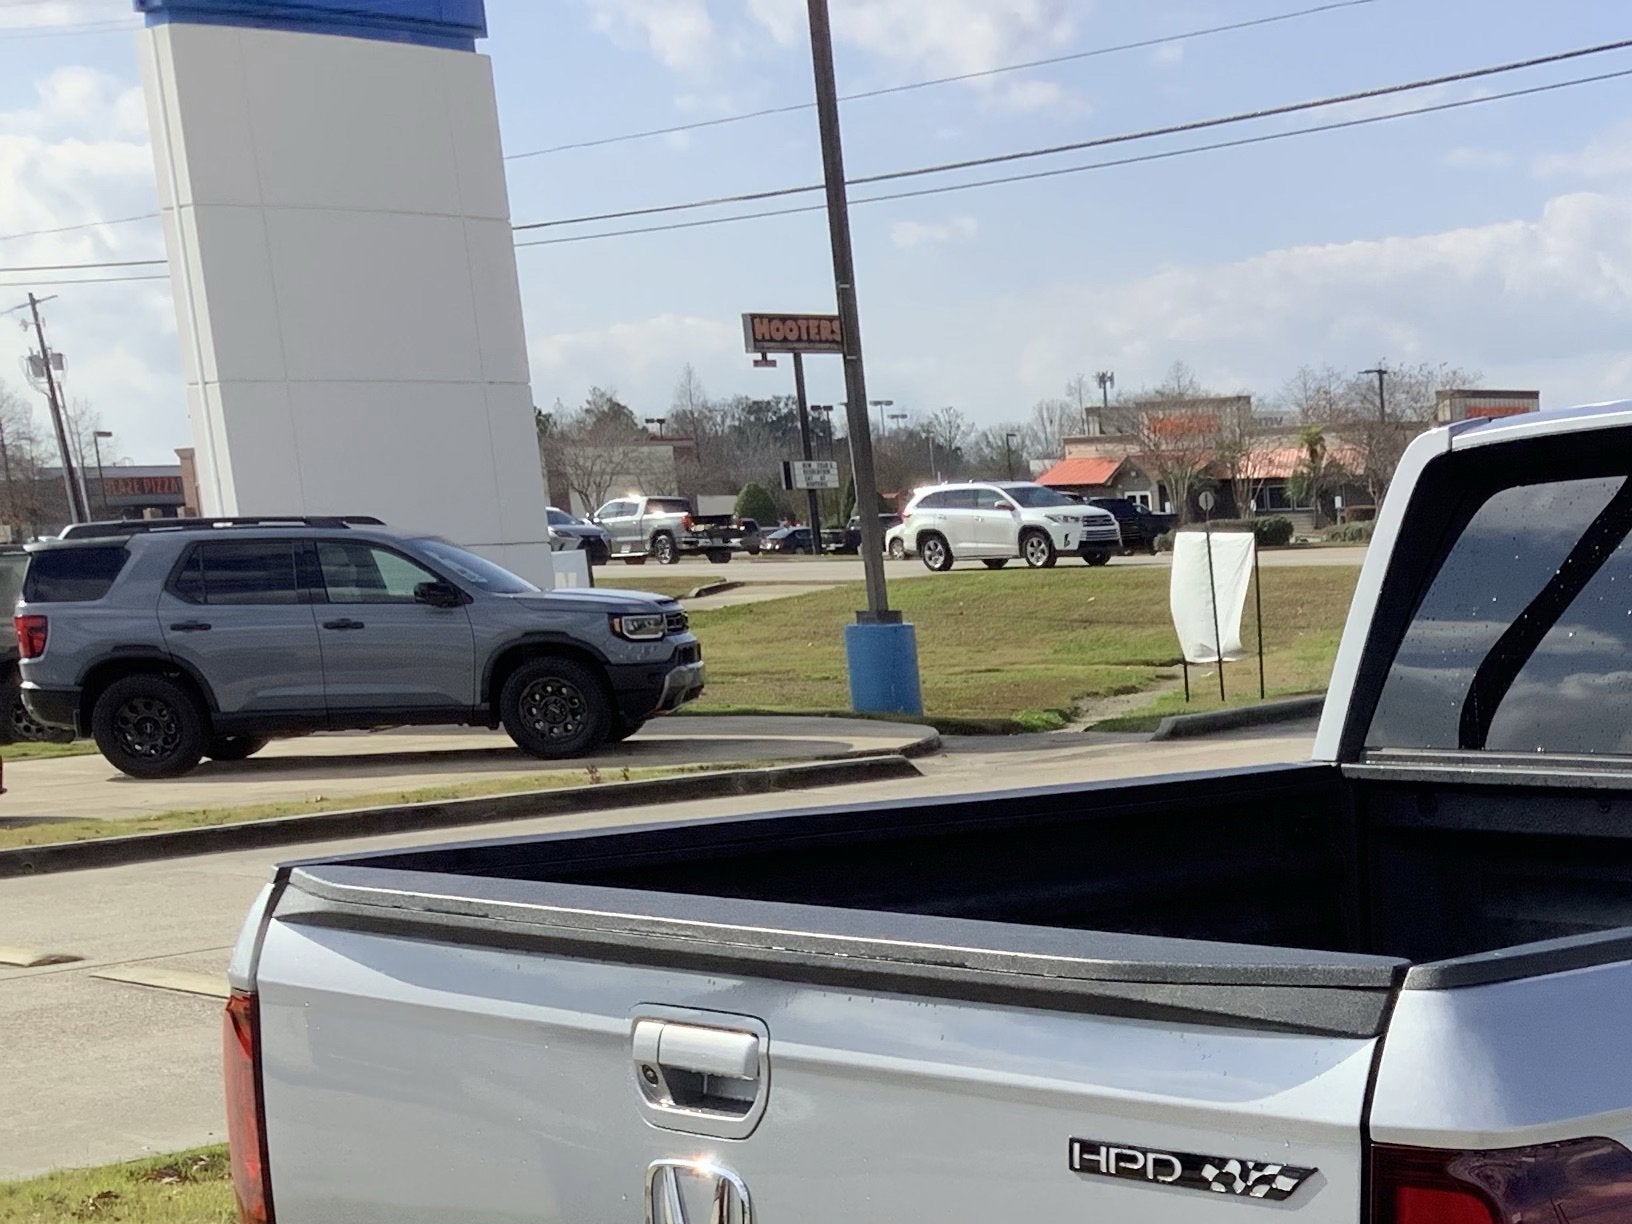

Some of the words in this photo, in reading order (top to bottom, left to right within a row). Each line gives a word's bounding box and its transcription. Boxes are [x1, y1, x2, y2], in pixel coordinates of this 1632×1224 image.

[753, 318, 841, 341] HOOTERS
[143, 478, 178, 493] PIZZA
[1072, 1142, 1183, 1182] HPD
